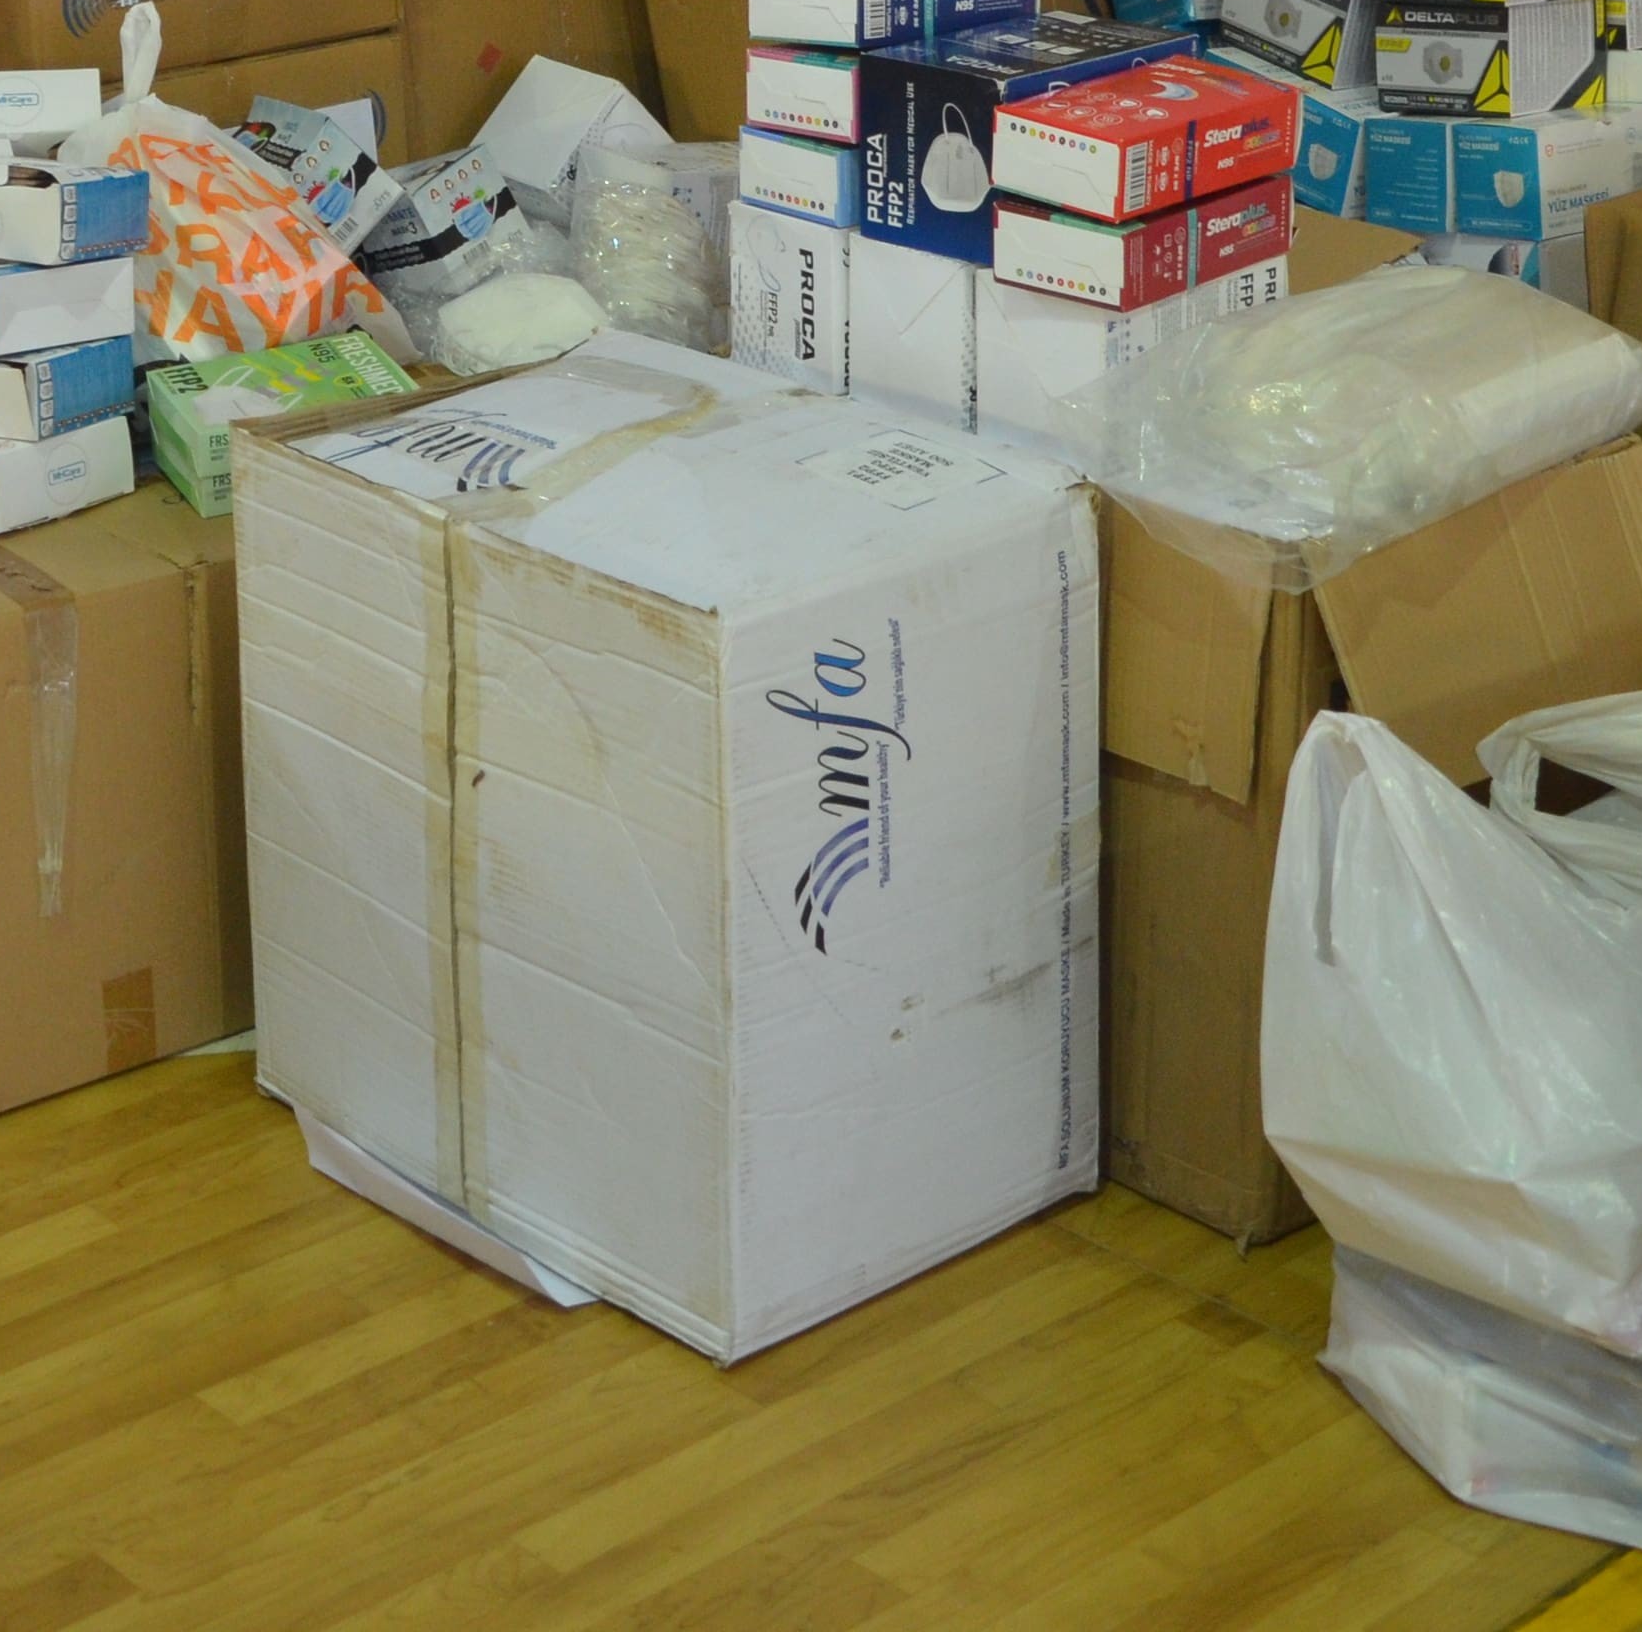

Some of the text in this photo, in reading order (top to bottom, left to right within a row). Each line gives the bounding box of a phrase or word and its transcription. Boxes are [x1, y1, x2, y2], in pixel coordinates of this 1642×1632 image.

[954, 0, 975, 13] N95
[1403, 11, 1500, 26] DELTAPLUS
[906, 81, 916, 99] USE
[906, 99, 916, 135] MEDICAL
[906, 137, 916, 152] FOR
[906, 153, 916, 173] MASK
[1217, 156, 1235, 170] N95
[866, 133, 885, 224] PROCA
[887, 179, 905, 229] FFP2
[1547, 198, 1570, 214] YÜZ
[1218, 244, 1235, 258] N95
[767, 291, 779, 325] FFP2
[798, 247, 817, 361] PROCA
[308, 341, 337, 365] N95
[764, 637, 912, 817] mfa
[876, 780, 891, 803] your
[876, 804, 890, 814] of
[876, 815, 891, 845] friend
[1060, 830, 1071, 885] TURKEY
[1060, 900, 1071, 937] Made
[1058, 947, 1071, 995] MASKE
[1058, 995, 1071, 1073] KORUYUCU
[1058, 1073, 1071, 1141] SOLUNUM
[1058, 1141, 1071, 1170] MFA
